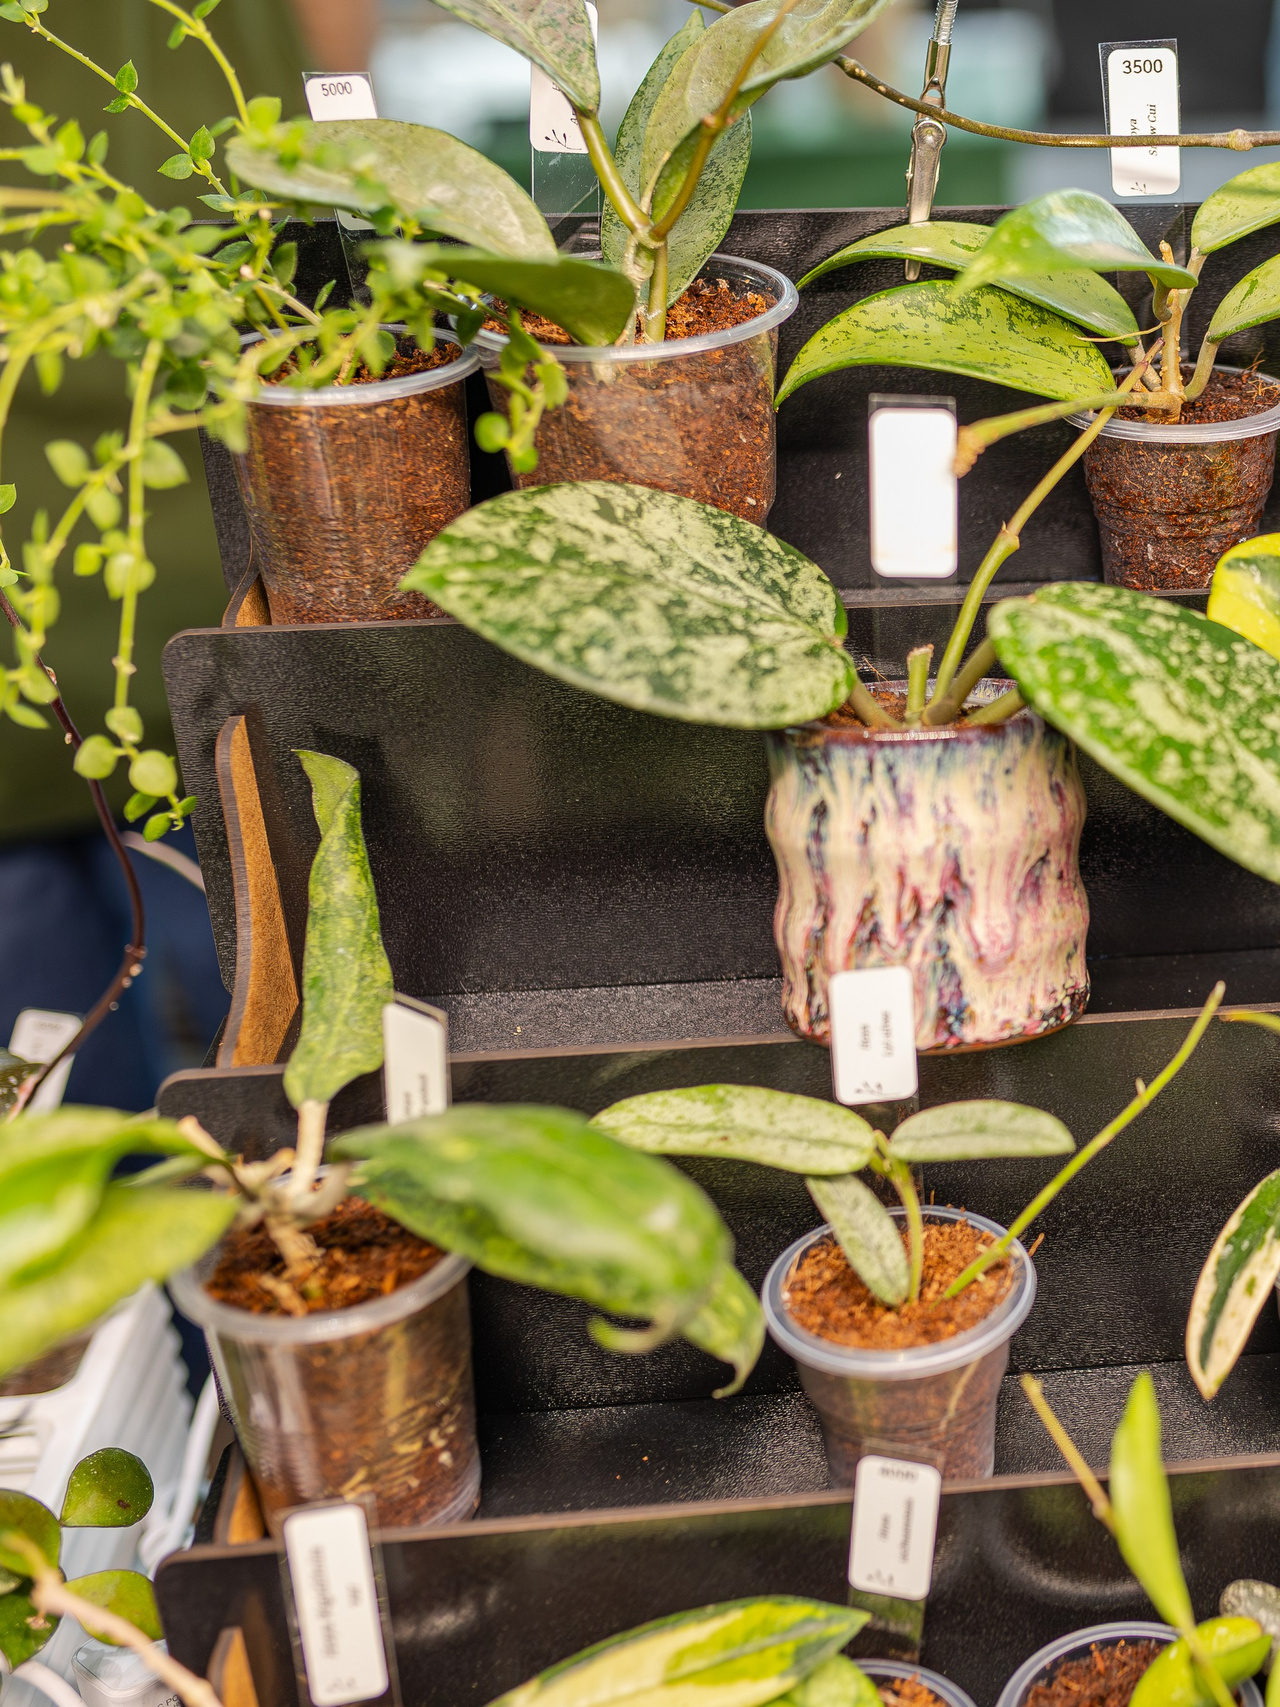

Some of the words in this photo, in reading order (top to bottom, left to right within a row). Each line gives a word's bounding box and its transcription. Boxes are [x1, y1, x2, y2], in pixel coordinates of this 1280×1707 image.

[1122, 59, 1163, 74] 3500
[321, 81, 353, 97] 5000
[1146, 103, 1157, 123] Cui
